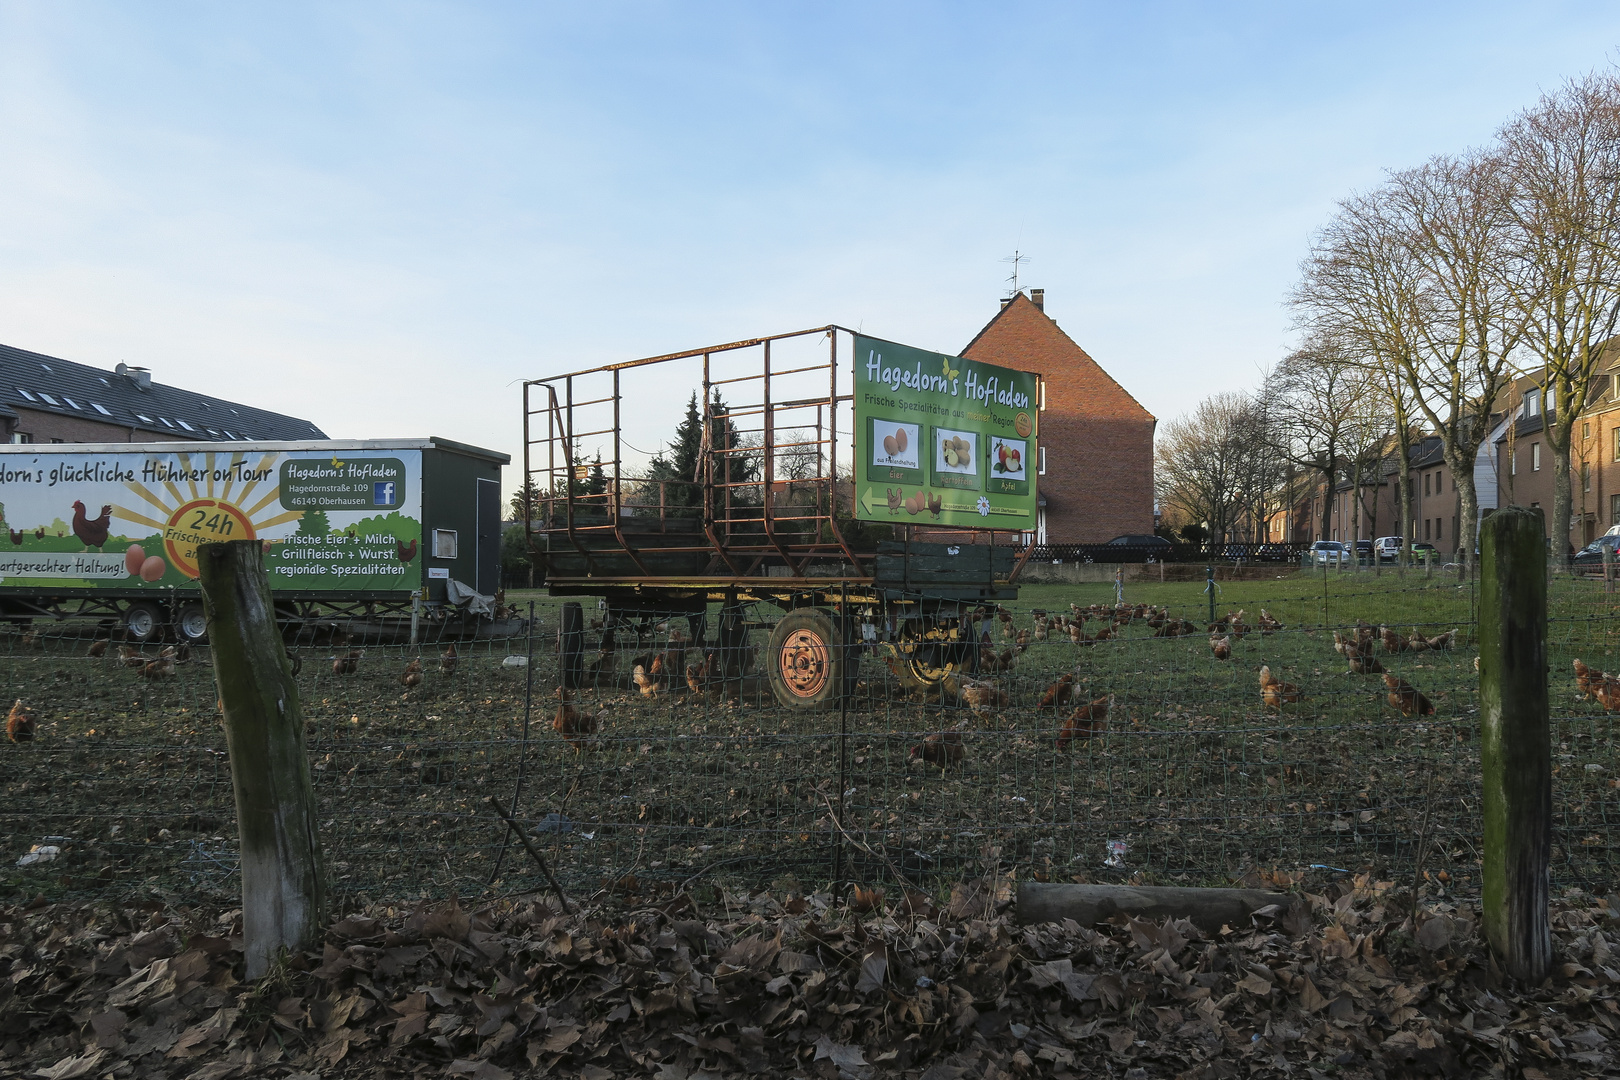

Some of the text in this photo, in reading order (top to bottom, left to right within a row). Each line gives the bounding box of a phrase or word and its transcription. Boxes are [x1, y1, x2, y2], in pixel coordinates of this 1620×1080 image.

[965, 369, 1029, 409] Hofladen
[864, 393, 895, 407] Frische
[898, 399, 949, 416] Spezialitäten
[952, 410, 964, 418] aus
[967, 411, 991, 423] meiner
[992, 414, 1014, 428] Region
[49, 460, 135, 487] glückliche
[142, 460, 209, 483] Hühner
[347, 463, 398, 479] Hofladen
[889, 470, 904, 480] Eier
[289, 483, 369, 493] Hagedornstraße 109
[1001, 479, 1016, 491] Äpfel
[291, 496, 366, 506] 46149 Oberhausen
[190, 510, 233, 536] 24h
[283, 533, 322, 545] frische
[326, 534, 349, 544] Eier
[365, 533, 396, 544] Milch
[282, 548, 343, 560] Grillfleisch
[359, 549, 394, 560] Wurst
[0, 558, 125, 577] artgerechter Haltung!
[275, 564, 326, 577] regionale
[331, 563, 405, 578] Spezialitäten
